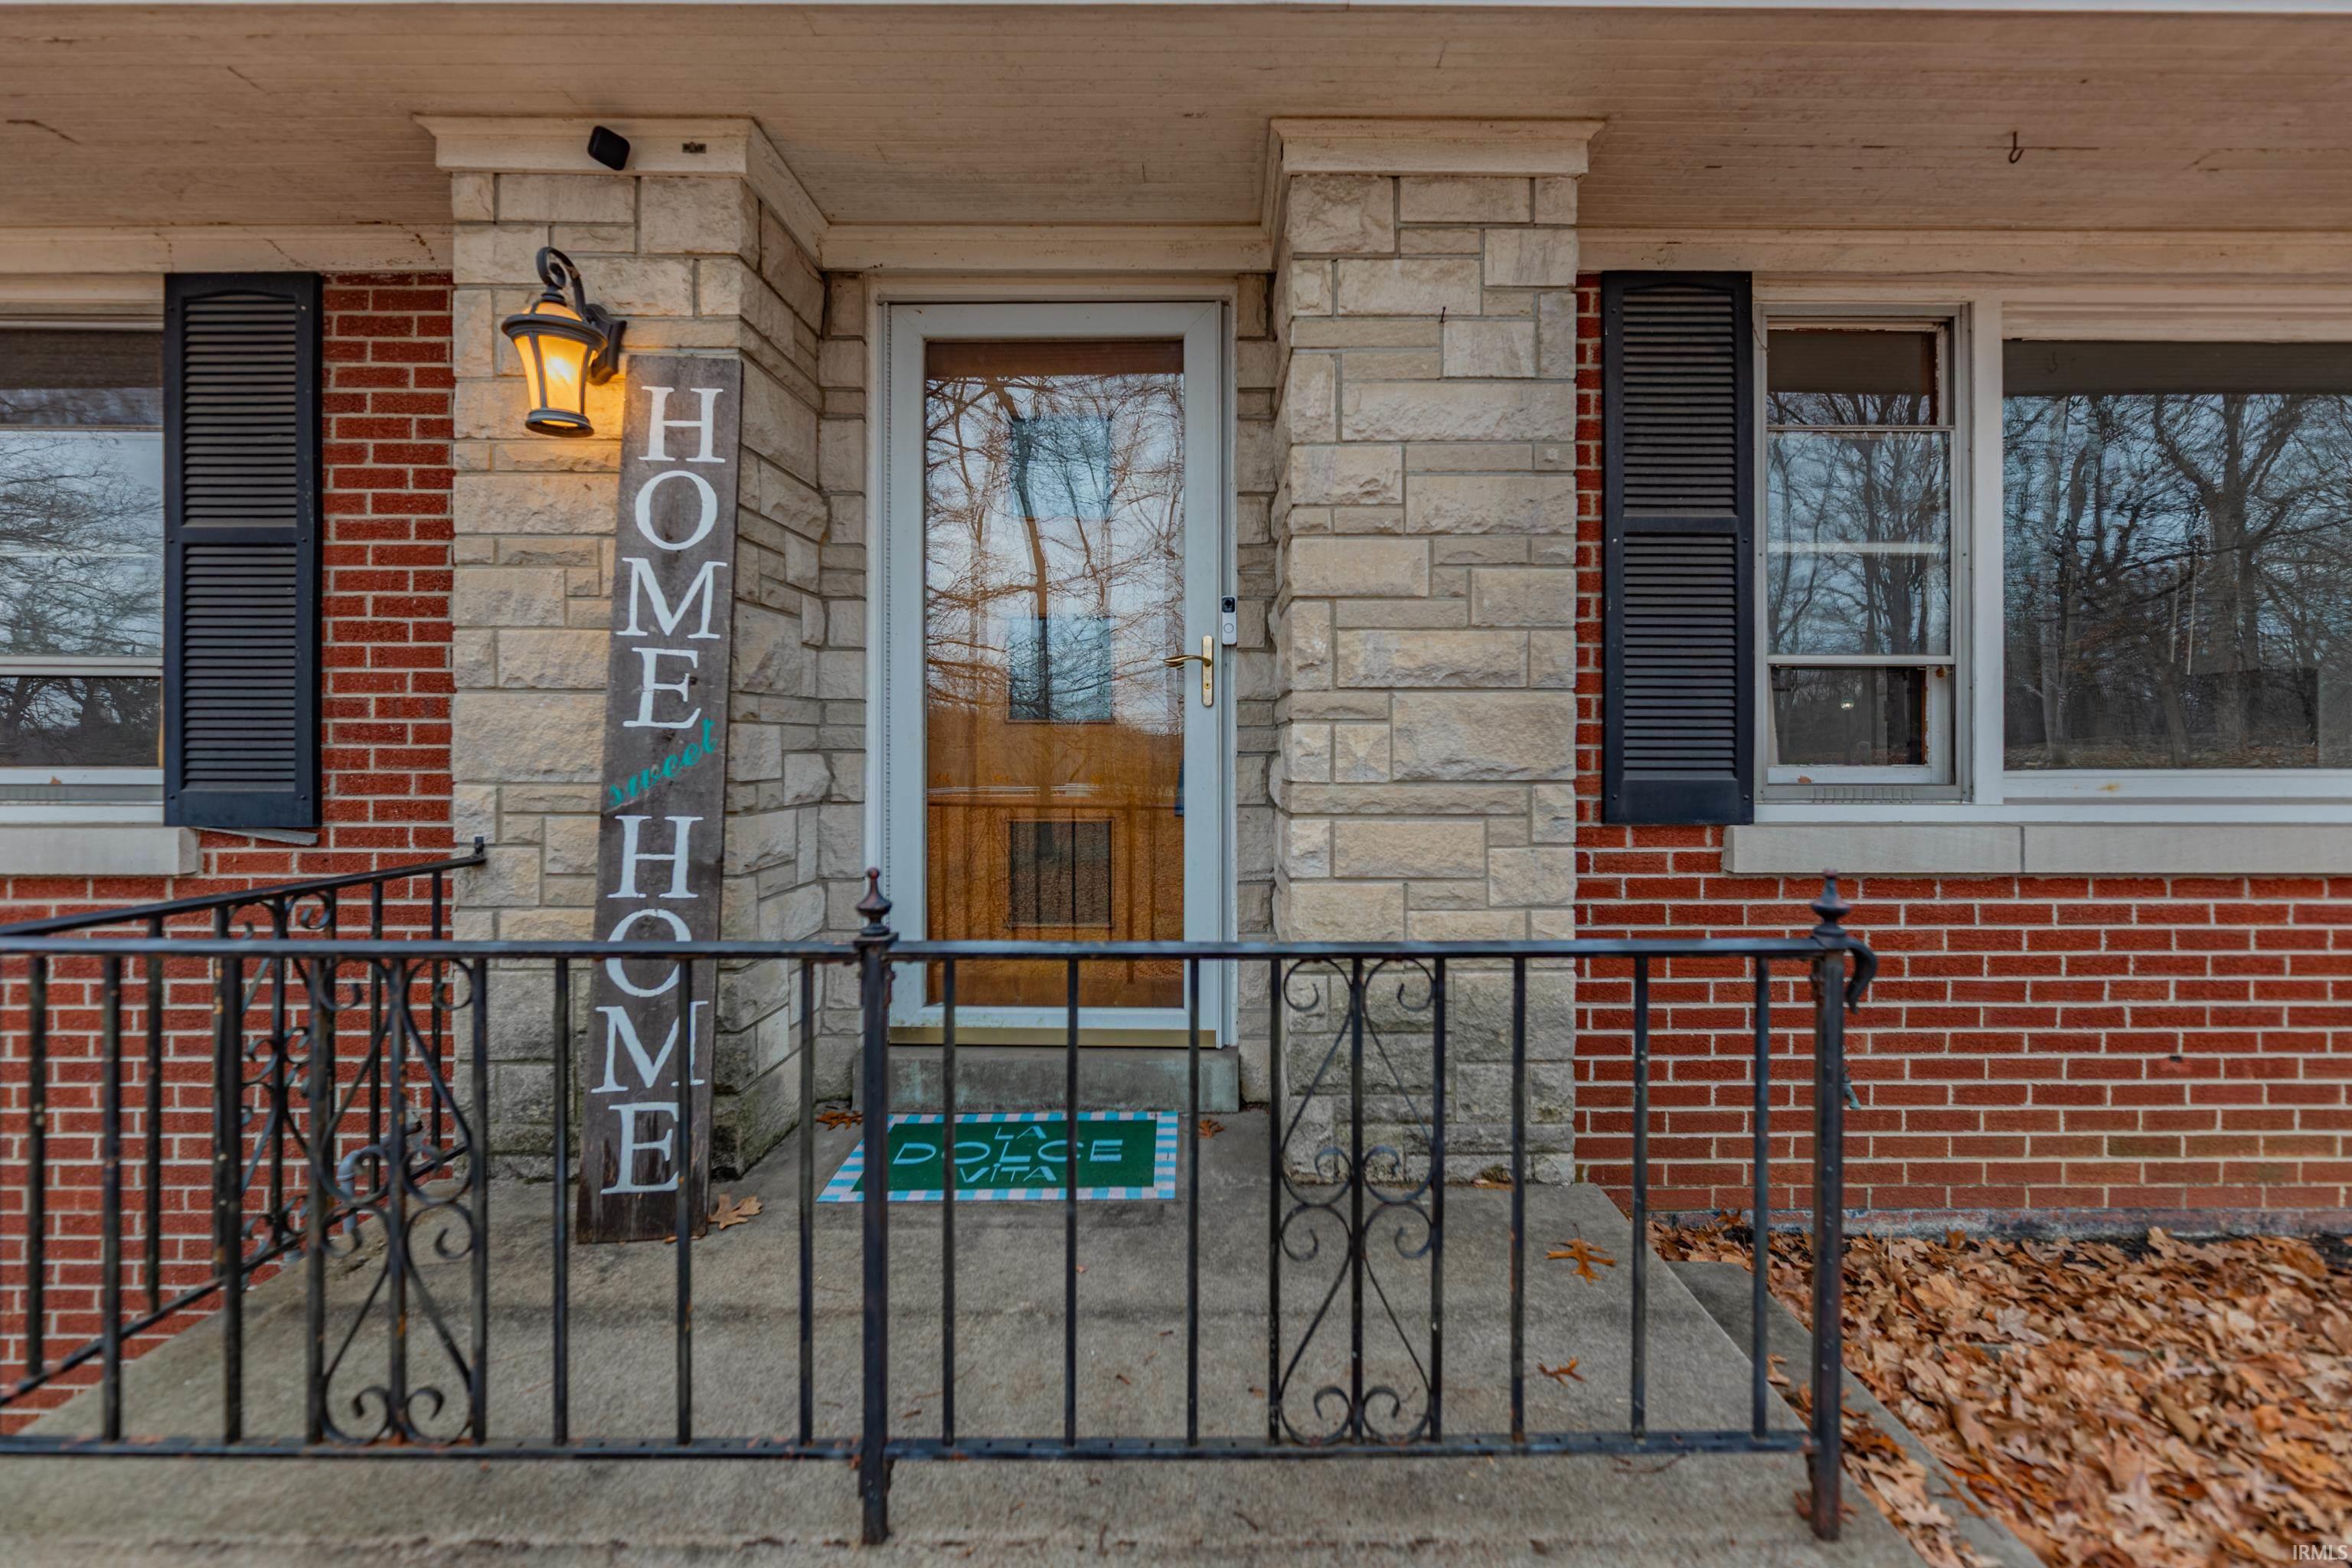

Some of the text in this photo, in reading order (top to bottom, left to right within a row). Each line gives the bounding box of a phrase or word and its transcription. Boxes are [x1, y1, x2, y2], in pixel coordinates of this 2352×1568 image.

[616, 386, 727, 729] HOME
[607, 717, 718, 808] sweet
[591, 815, 708, 1195] HOME
[893, 1139, 1123, 1165] DOLCE
[995, 1125, 1047, 1140] LA
[959, 1163, 1057, 1183] VITA
